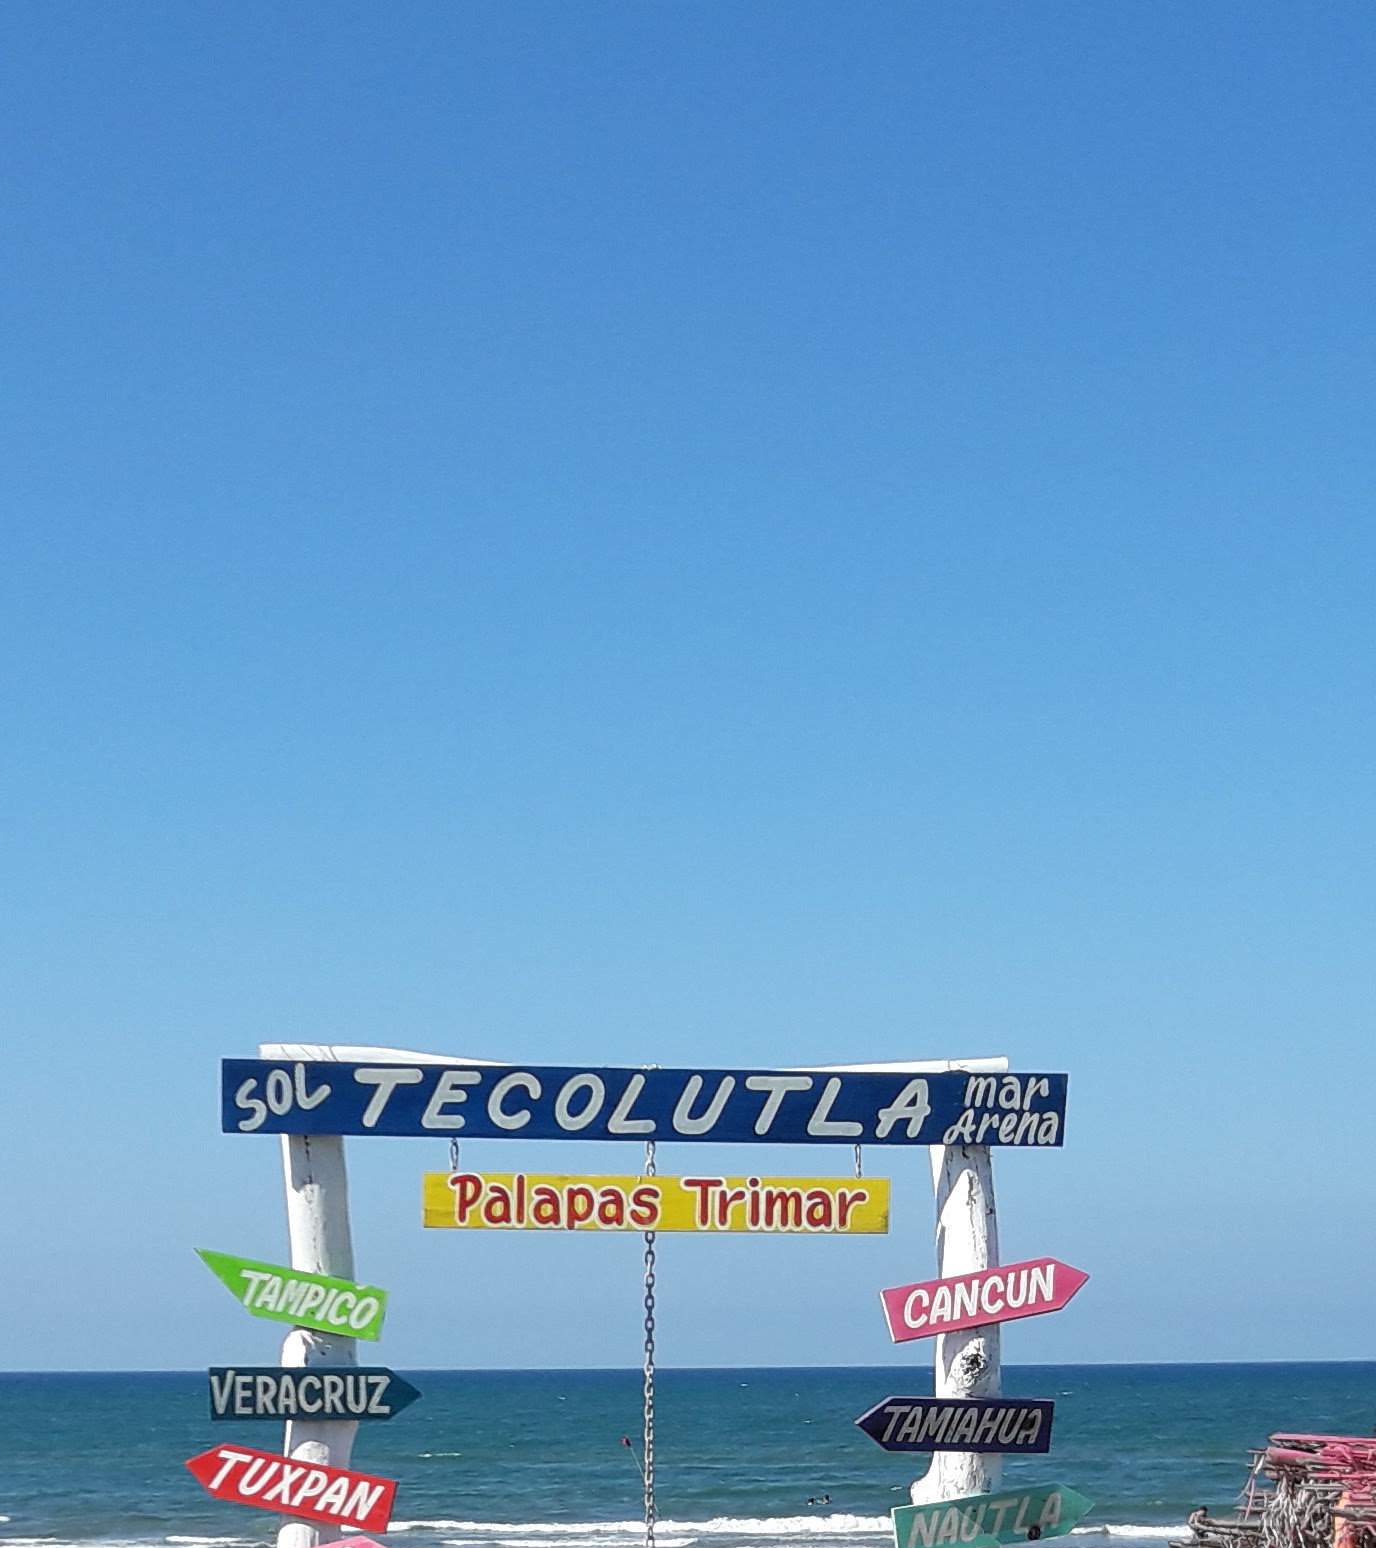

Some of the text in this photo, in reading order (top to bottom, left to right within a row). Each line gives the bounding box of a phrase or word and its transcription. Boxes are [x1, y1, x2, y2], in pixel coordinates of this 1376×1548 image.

[235, 1063, 332, 1131] SOL
[353, 1067, 932, 1139] TECOLUTLA
[964, 1075, 1050, 1111] mar
[942, 1108, 1059, 1145] Arena
[449, 1173, 868, 1230] Palapas Trimar
[240, 1269, 380, 1330] TAMPICO
[903, 1264, 1055, 1328] CANCUN
[210, 1370, 391, 1415] VERACRUZ
[881, 1405, 1042, 1445] TAMIAHUA
[208, 1450, 385, 1521] TUXPAN
